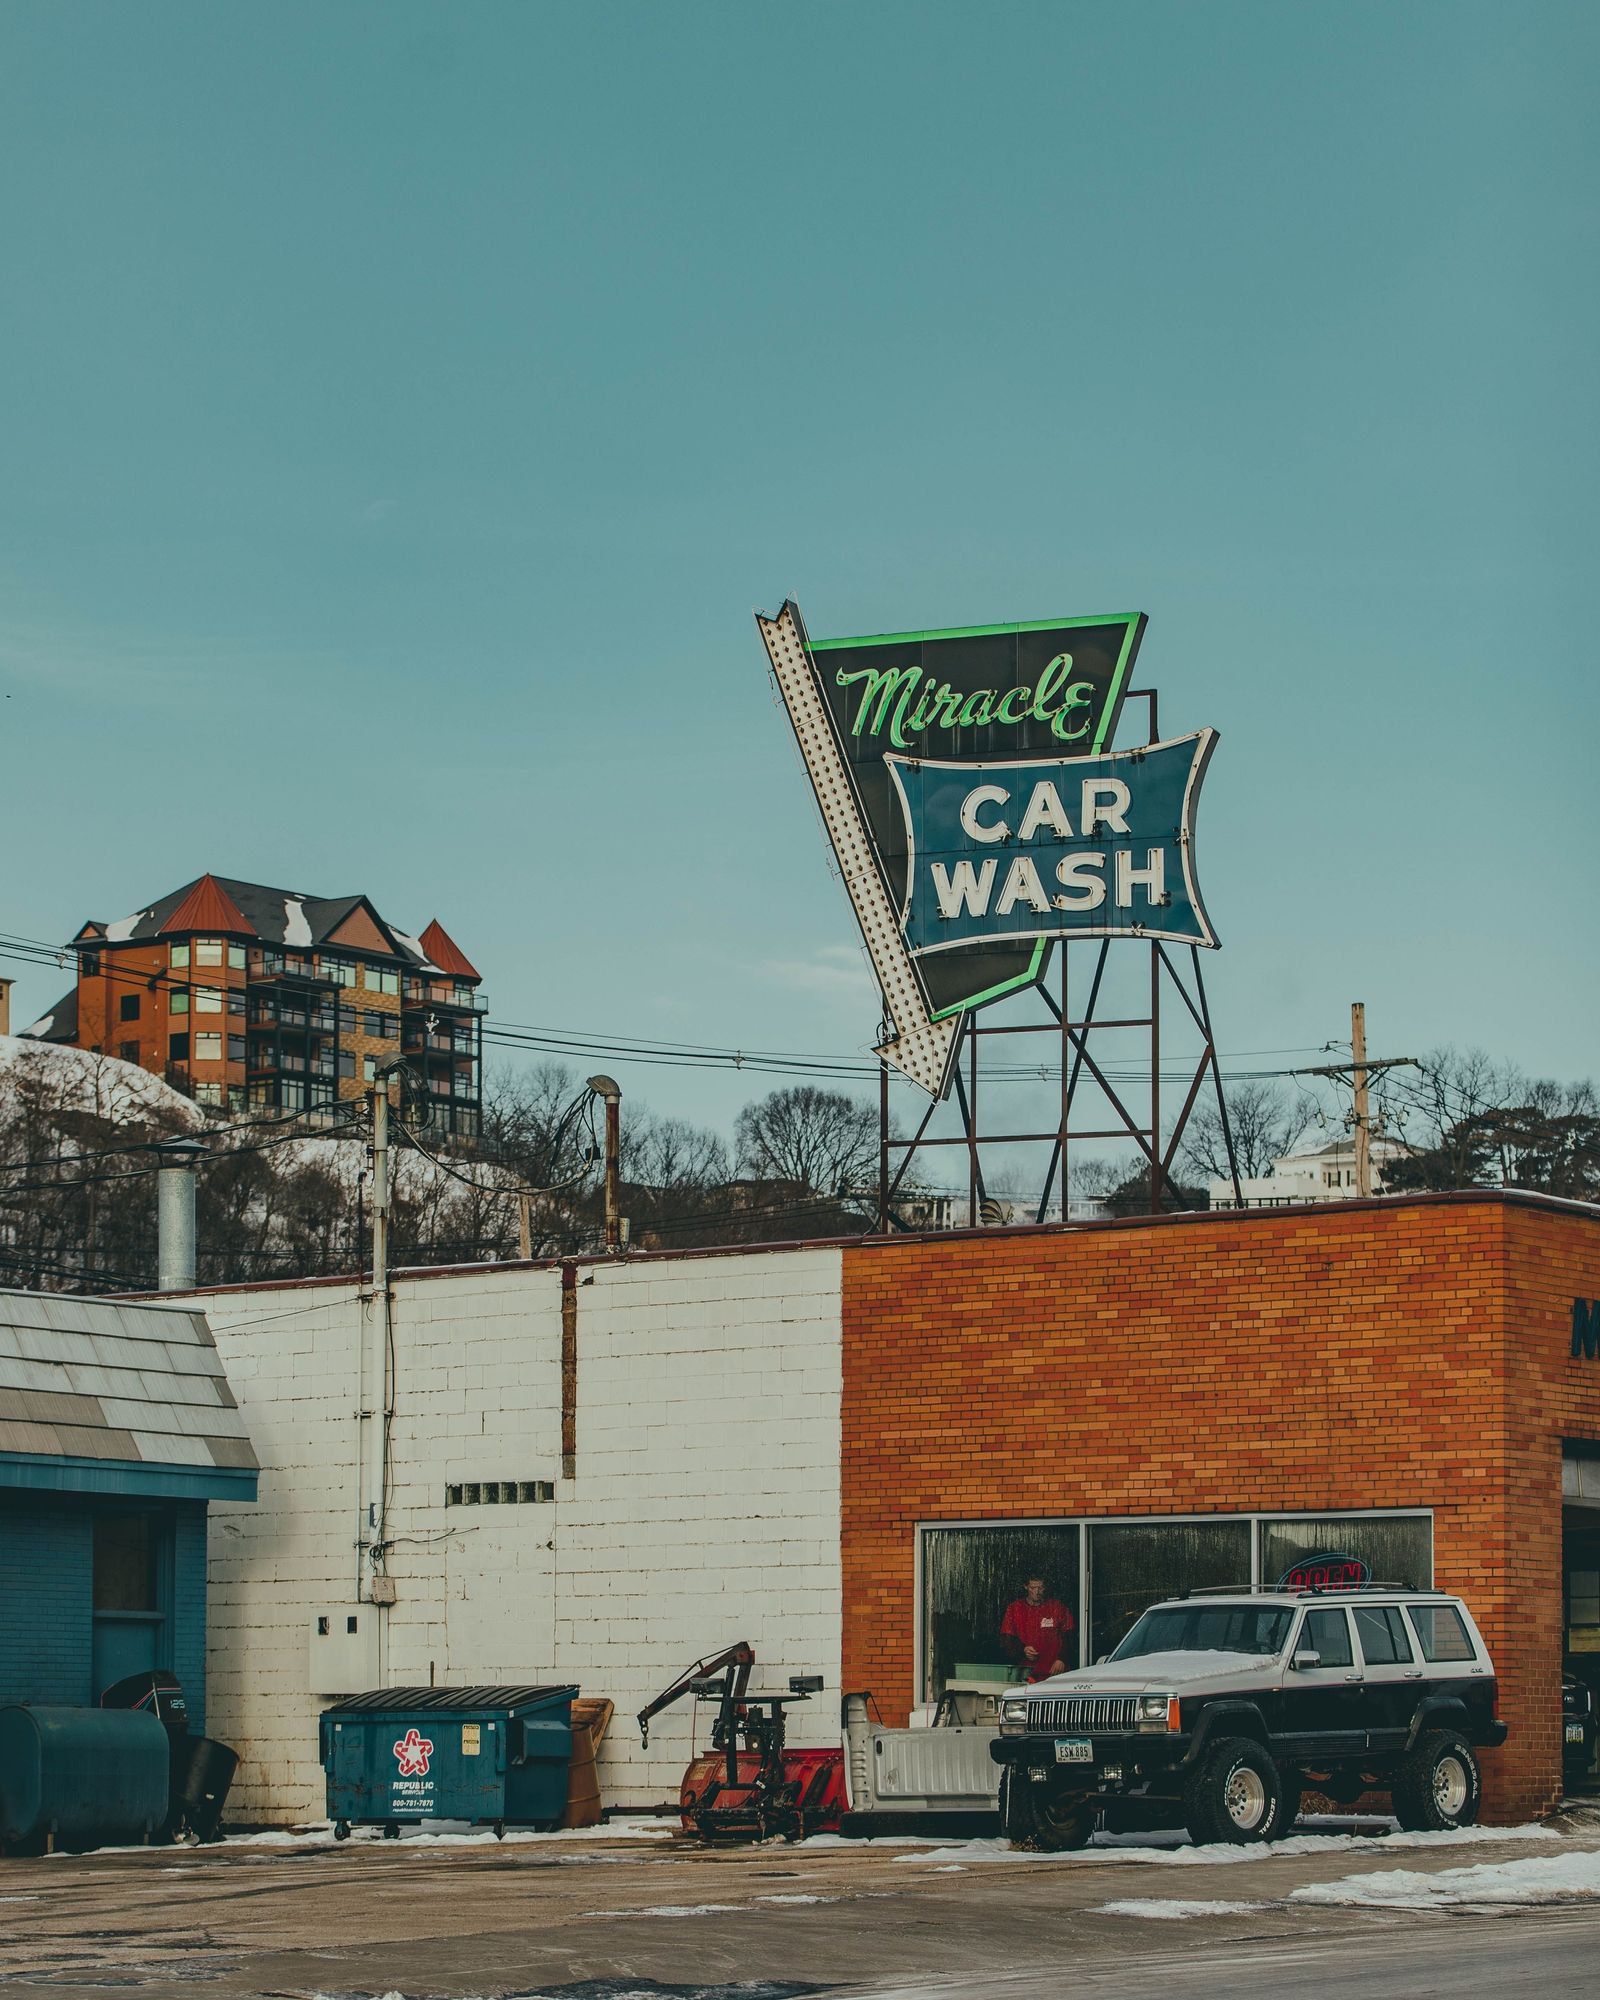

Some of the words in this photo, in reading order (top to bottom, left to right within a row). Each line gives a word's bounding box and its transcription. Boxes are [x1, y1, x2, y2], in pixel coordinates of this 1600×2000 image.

[836, 653, 1097, 748] Miracle
[960, 779, 1131, 843] CAR
[930, 848, 1166, 918] WASH
[1060, 1746, 1074, 1758] ESW
[1075, 1746, 1089, 1758] 885
[1454, 1743, 1478, 1800] GENERAL
[393, 1782, 434, 1790] REPUBLIC
[1258, 1797, 1276, 1835] GENERAL
